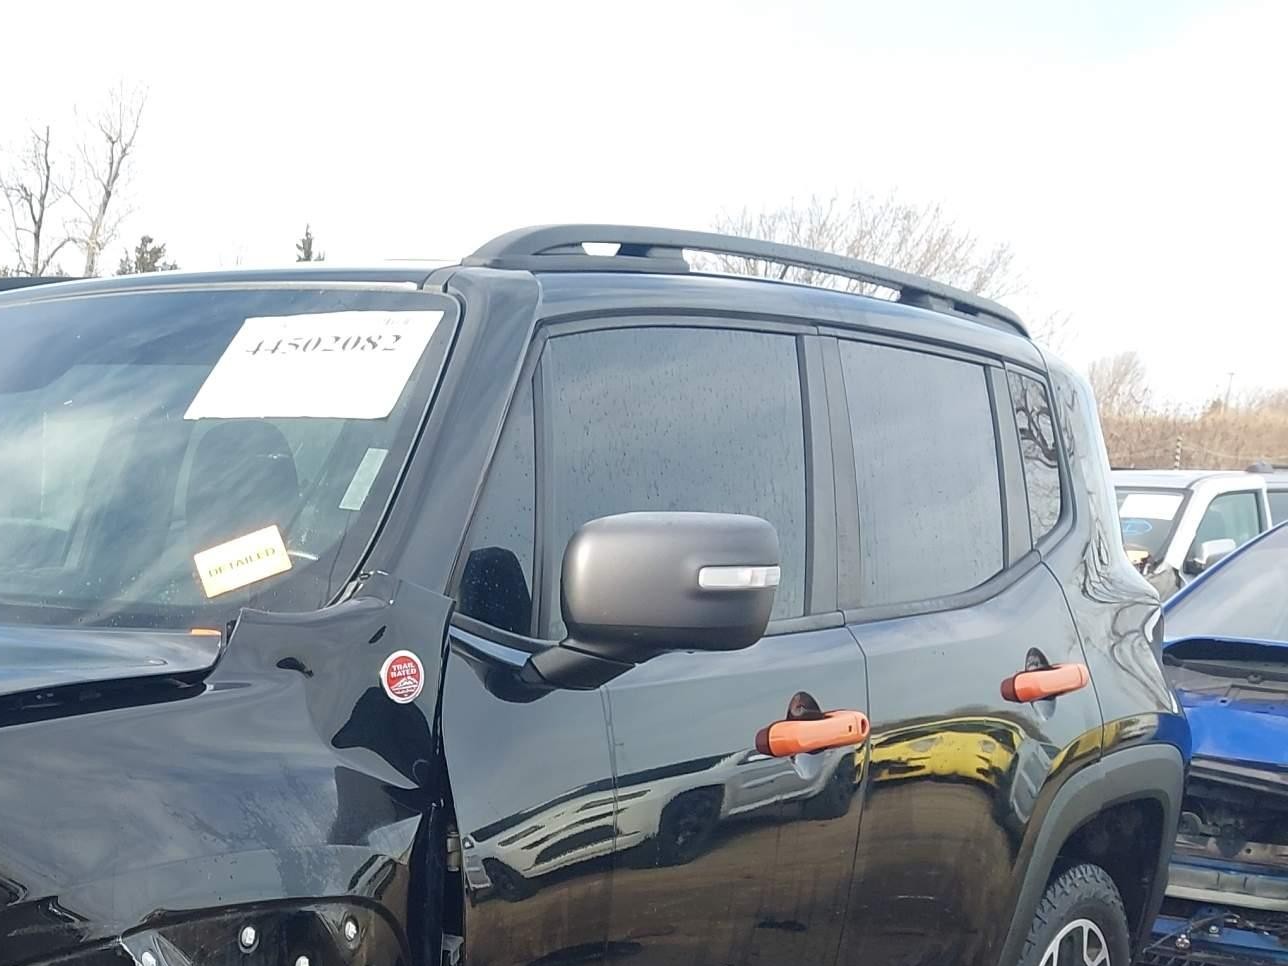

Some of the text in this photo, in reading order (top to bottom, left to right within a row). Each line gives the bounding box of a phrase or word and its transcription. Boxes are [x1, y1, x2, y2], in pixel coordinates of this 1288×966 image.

[244, 334, 402, 356] 44502082
[392, 662, 416, 672] TRAIL
[390, 668, 417, 679] RATED
